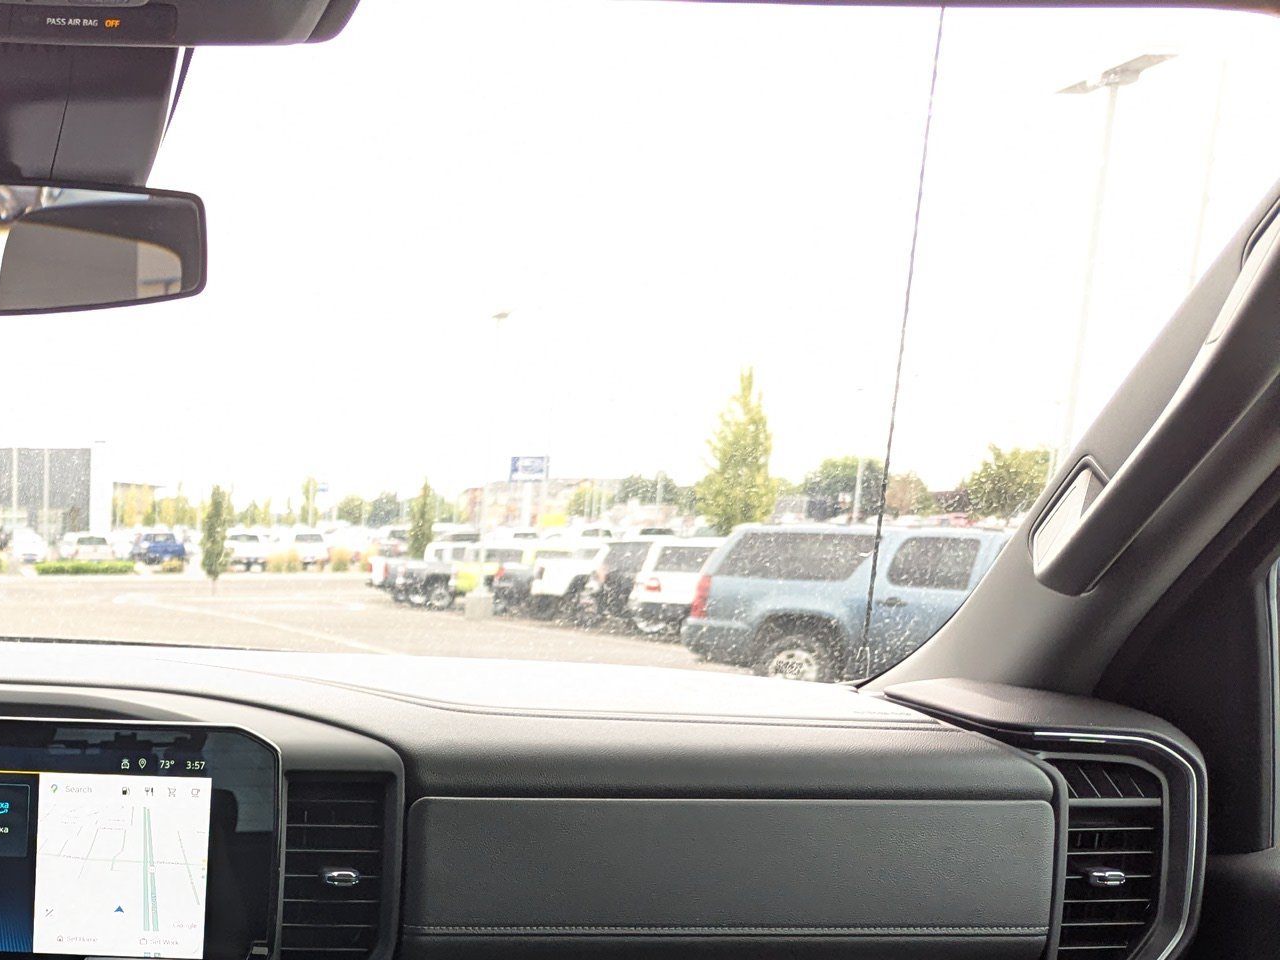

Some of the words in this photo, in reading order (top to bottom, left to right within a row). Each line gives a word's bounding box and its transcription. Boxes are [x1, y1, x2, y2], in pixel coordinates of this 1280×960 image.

[46, 17, 66, 26] PASS
[68, 18, 82, 27] AIR
[83, 19, 98, 27] BAG
[105, 19, 120, 28] OFF
[159, 760, 175, 769] 73°
[186, 761, 205, 770] 3:57
[65, 785, 93, 793] Search
